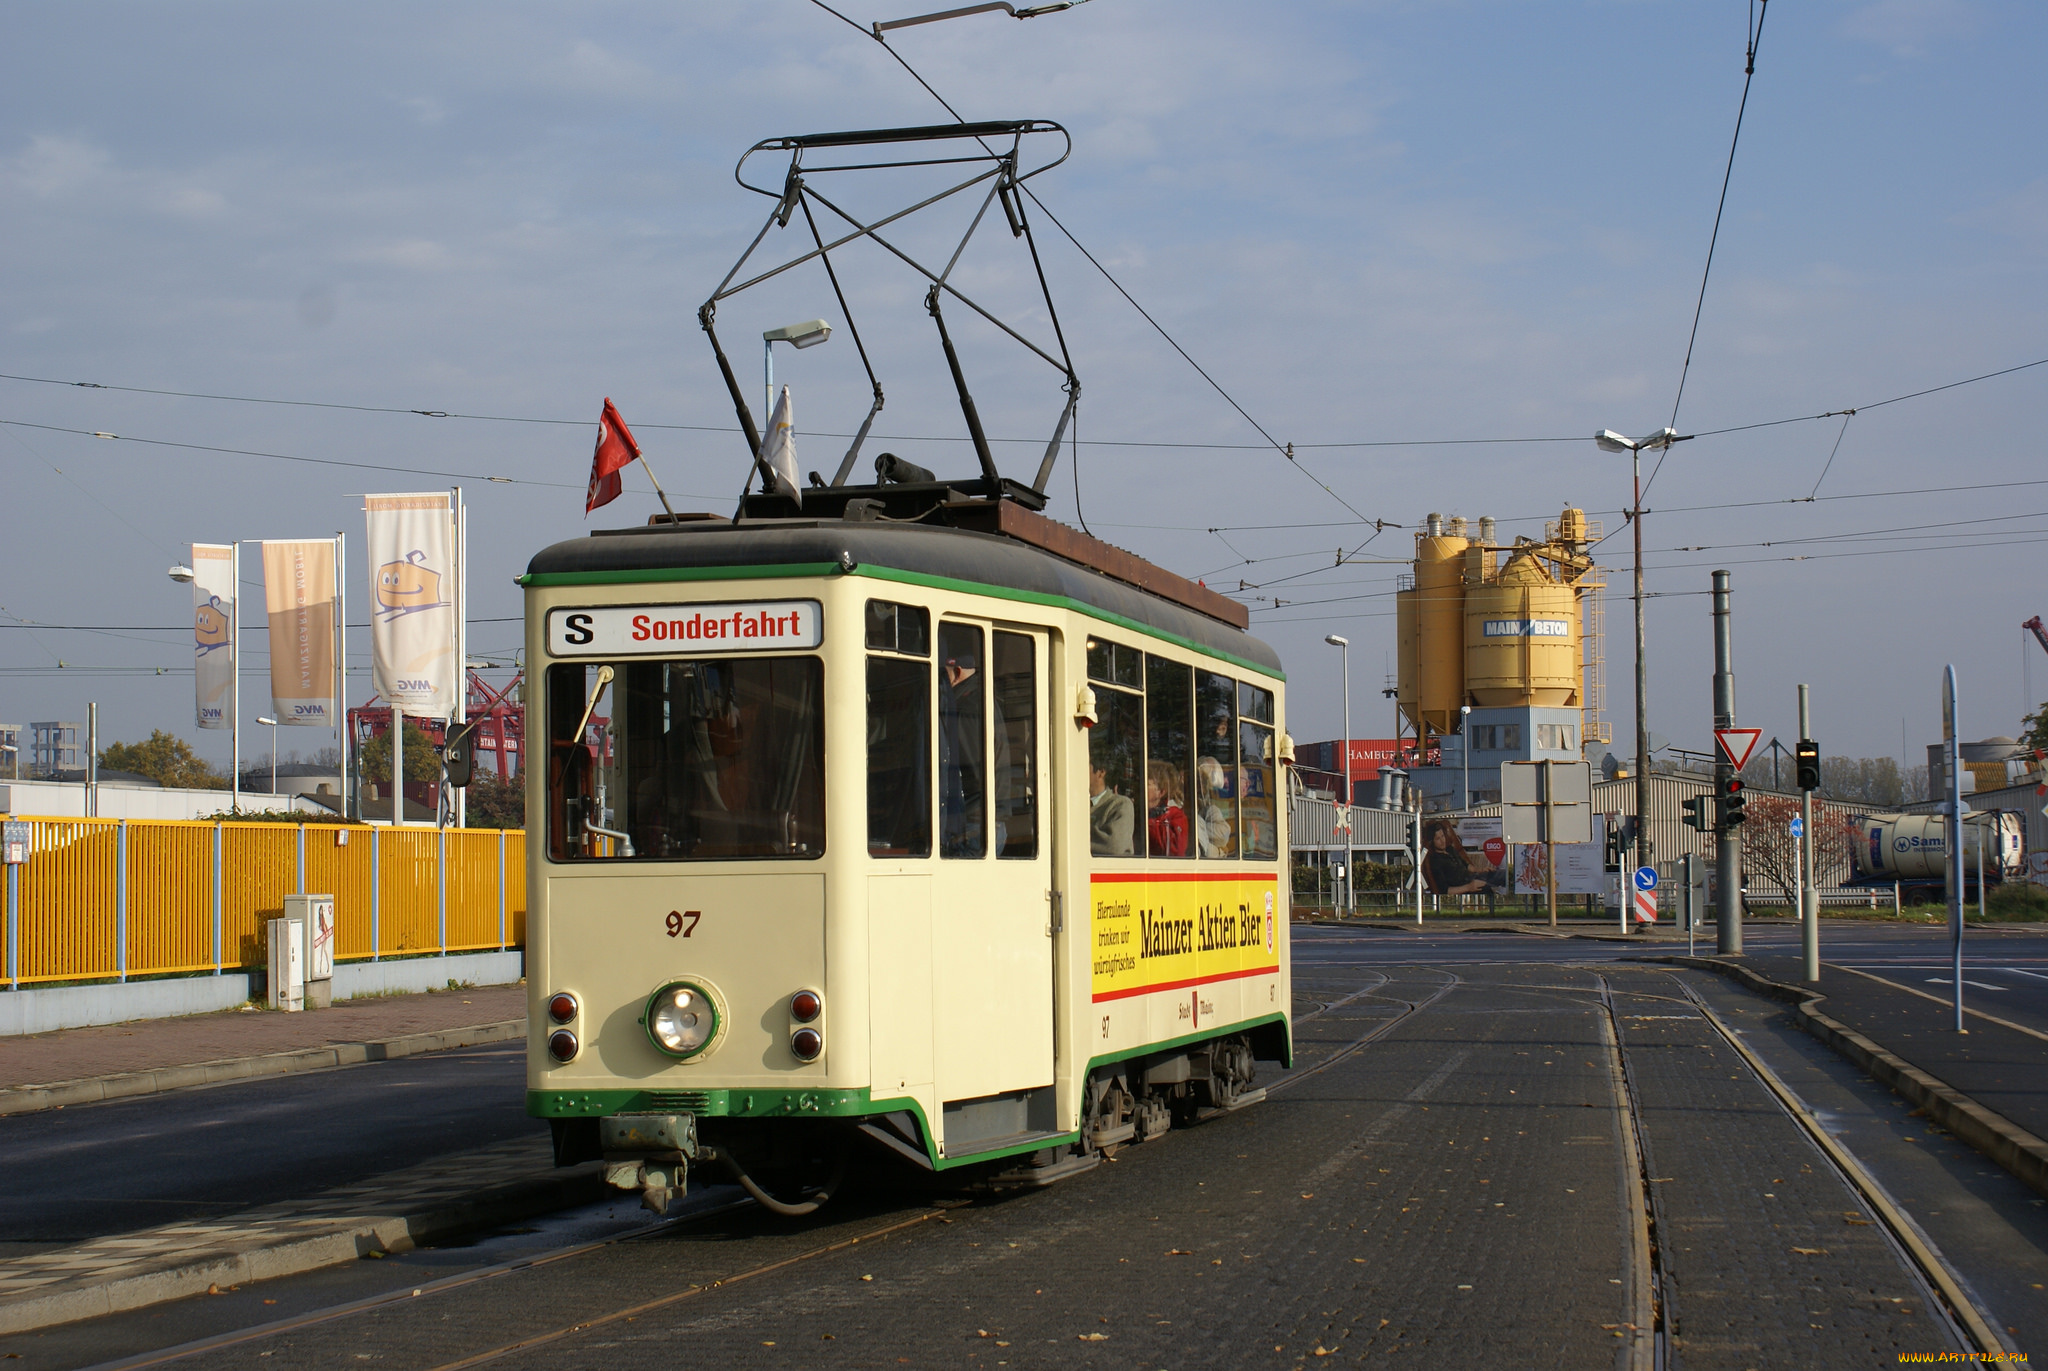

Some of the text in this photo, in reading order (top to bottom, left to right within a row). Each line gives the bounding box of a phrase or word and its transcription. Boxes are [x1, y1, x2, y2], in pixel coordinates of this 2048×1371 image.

[564, 610, 801, 646] S Sonderfahrt
[1486, 621, 1568, 636] MAIN BETON
[1349, 749, 1404, 761] HAMBUR
[1486, 842, 1501, 850] ERGO
[1097, 899, 1131, 920] Hierzulande
[664, 911, 701, 938] 97
[1098, 925, 1130, 947] trinken wir
[1140, 901, 1261, 959] Mainzer Aktien Bier
[1093, 953, 1136, 978] würzigfrisches
[1101, 1015, 1110, 1039] 97
